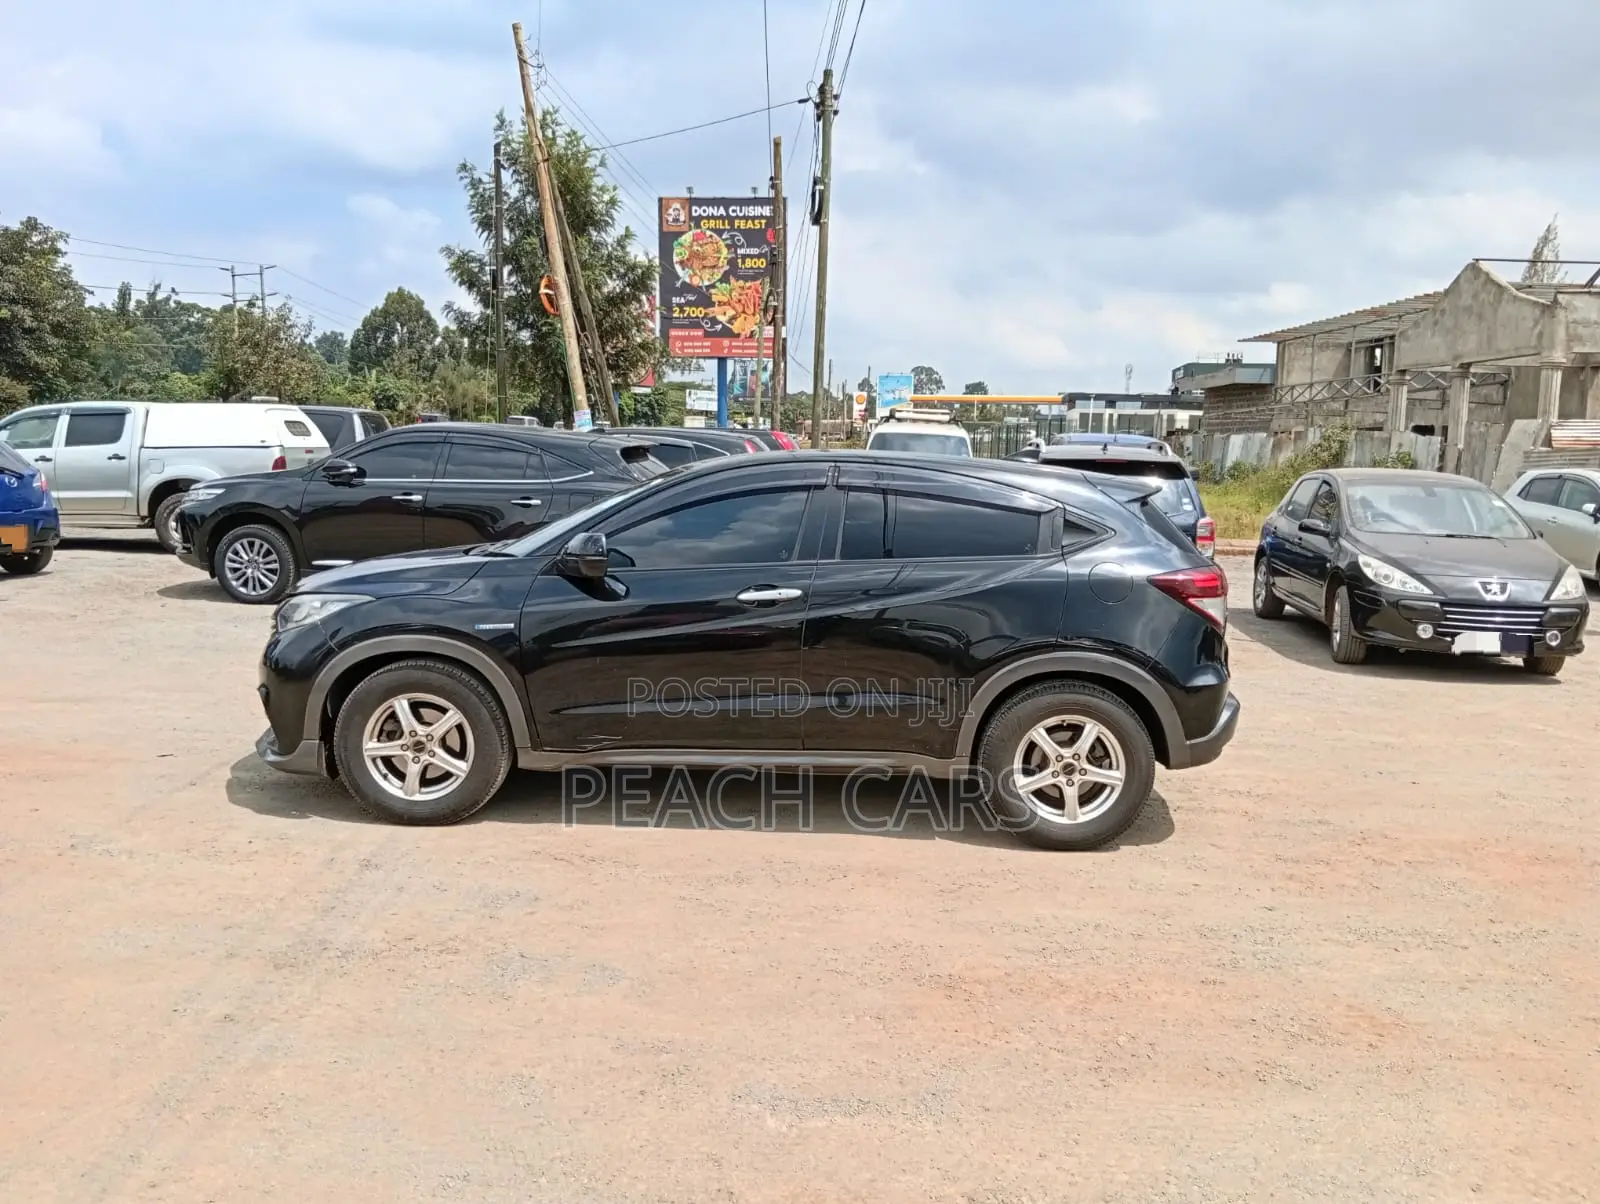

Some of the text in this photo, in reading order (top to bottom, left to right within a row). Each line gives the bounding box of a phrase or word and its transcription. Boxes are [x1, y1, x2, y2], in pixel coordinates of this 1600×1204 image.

[691, 206, 773, 217] DONA CUISINE
[701, 219, 767, 229] GRILL FEAST
[737, 258, 767, 269] 1,800
[672, 306, 705, 318] 2,700
